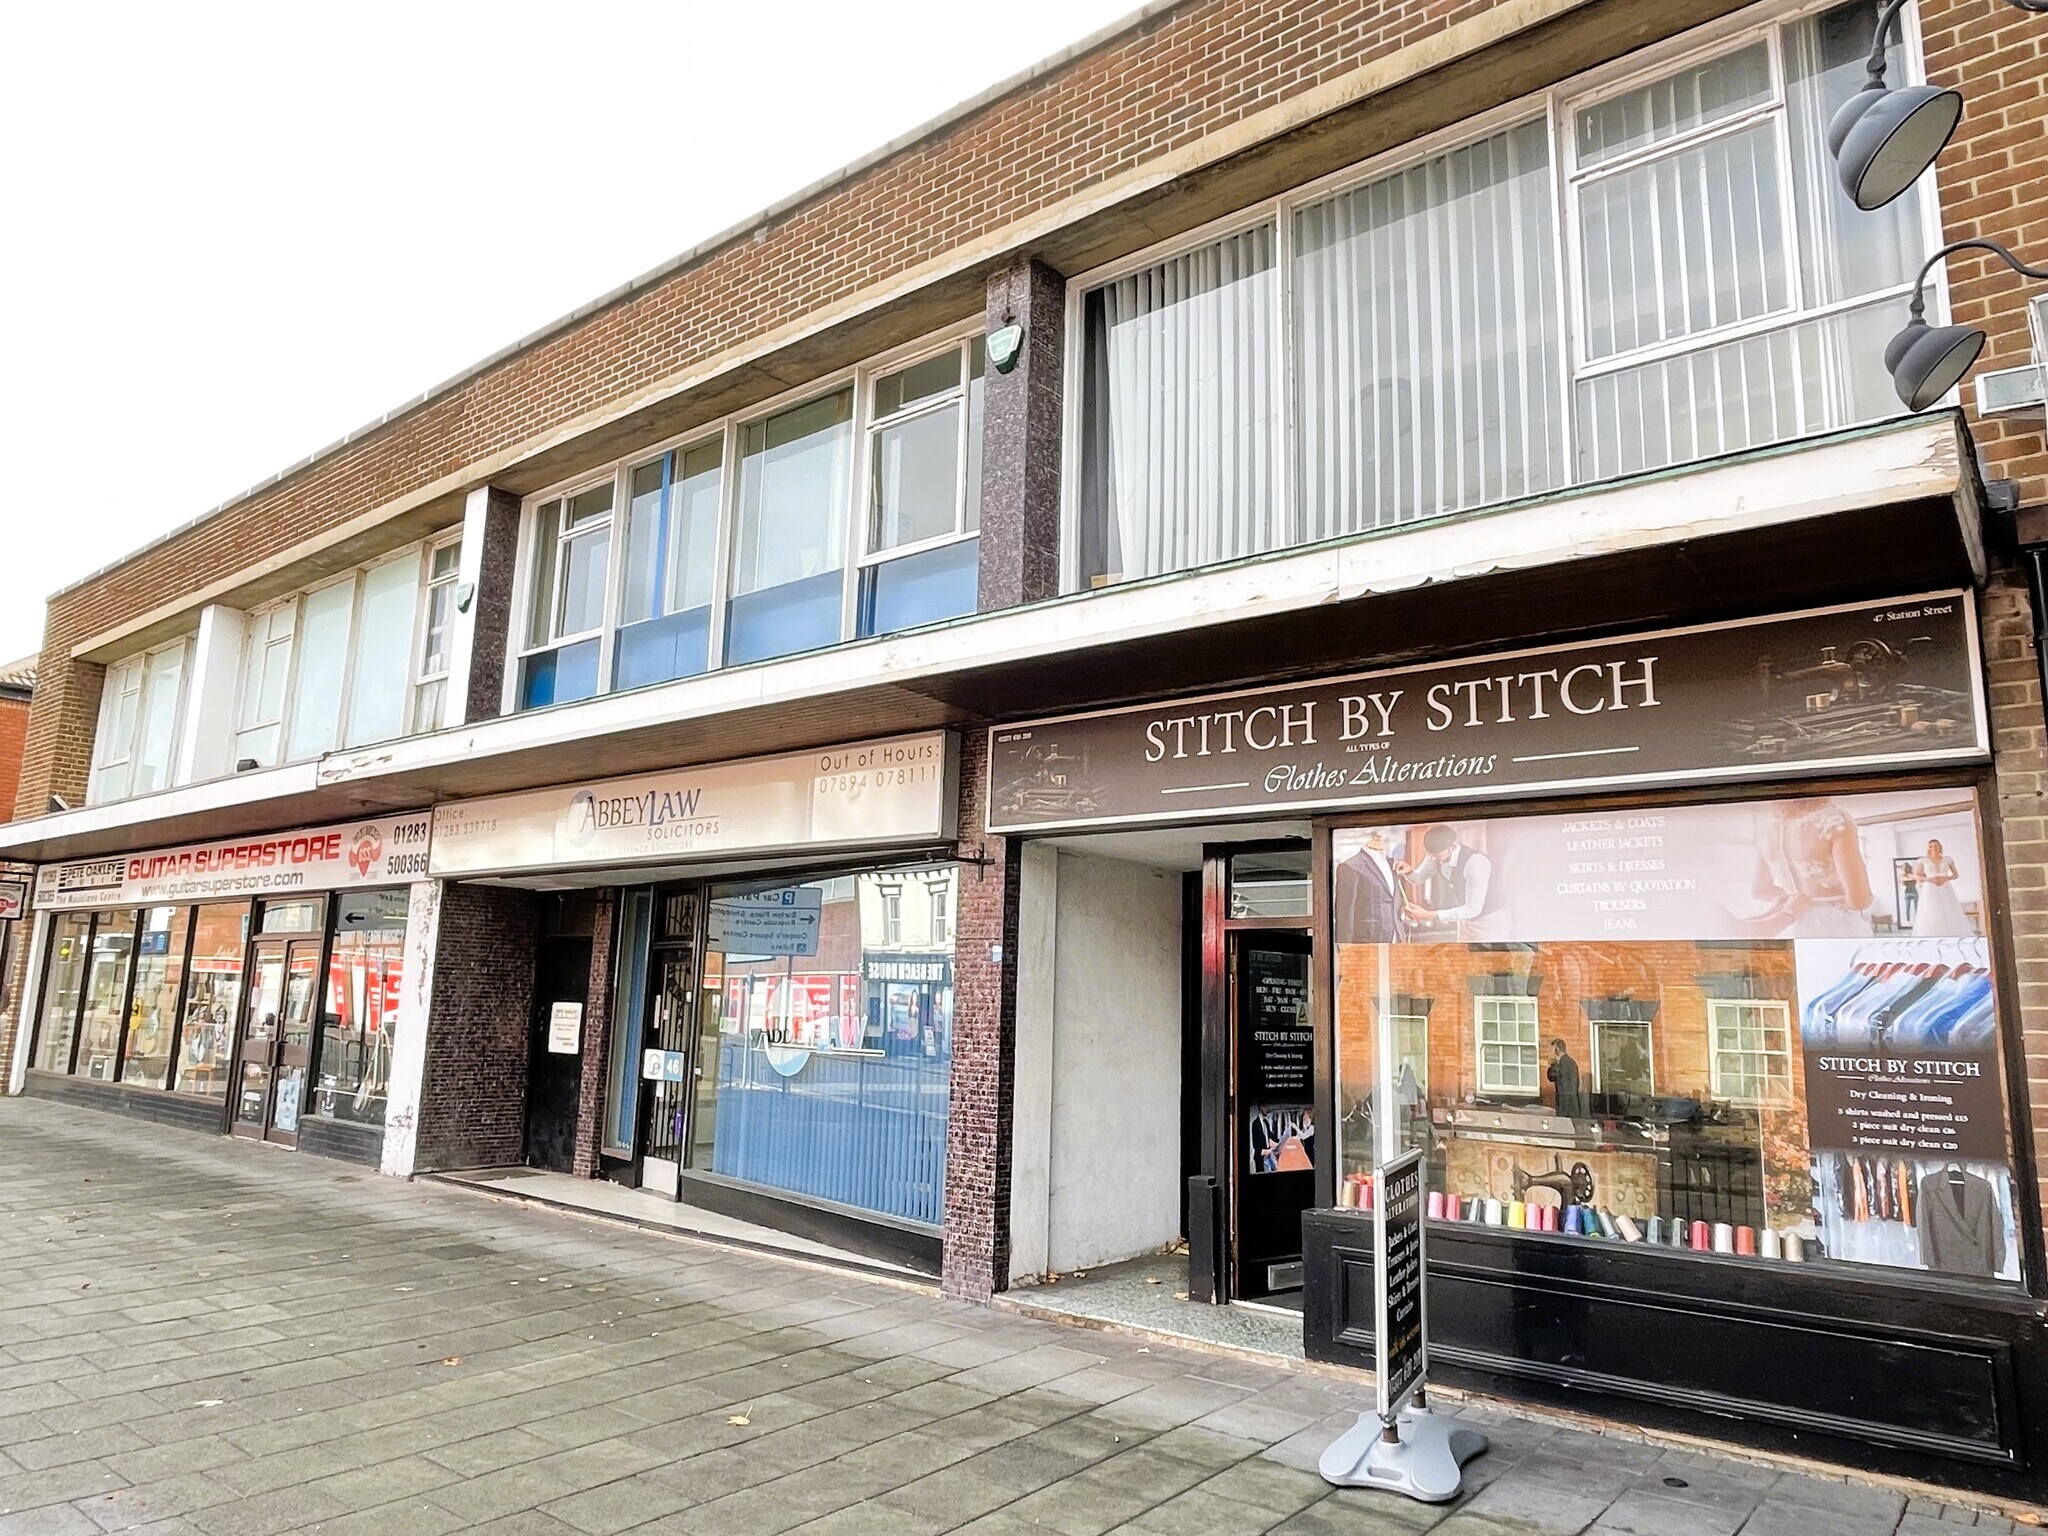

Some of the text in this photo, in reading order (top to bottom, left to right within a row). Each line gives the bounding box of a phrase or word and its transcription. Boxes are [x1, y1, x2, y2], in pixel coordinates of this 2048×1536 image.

[1886, 610, 1921, 621] Station
[1923, 605, 1953, 616] Street
[1145, 657, 1661, 762] STITCH BY STITCH
[820, 744, 940, 771] Out of Hours:
[820, 765, 936, 793] 07894 078111
[1264, 753, 1497, 793] Clothes Alterations
[646, 821, 720, 841] SOLICITORS
[1562, 816, 1666, 833] JACKETS & COATS
[394, 822, 427, 845] 01283
[1567, 836, 1664, 851] LEATHER JACKETS
[128, 853, 191, 880] GUITAR
[195, 833, 342, 873] SUPERSTORE
[387, 853, 428, 875] 500366
[67, 866, 84, 879] PETE
[86, 863, 117, 877] OAKLEY
[1568, 862, 1605, 874] SKIRTS
[1619, 859, 1665, 872] DRESSES
[141, 872, 303, 898] www.guitarsuperstore.com
[1557, 878, 1696, 895] CURTAINS BY QUOTATION
[1594, 899, 1647, 912] TROUSERS
[1604, 917, 1638, 931] JEANS
[1254, 1031, 1279, 1041] STITCH
[1290, 1032, 1313, 1042] STITCH
[666, 1059, 680, 1075] 46
[1819, 1056, 1981, 1077] STITCH BY STITCH
[1849, 1089, 1867, 1100] Dry
[1868, 1091, 1908, 1102] Cleaning
[1909, 1093, 1918, 1101] &
[1845, 1107, 1869, 1116] shirts
[1870, 1109, 1901, 1118] washed
[1902, 1111, 1919, 1119] and
[1859, 1122, 1880, 1131] piece
[1899, 1123, 1916, 1134] dry
[1917, 1124, 1941, 1134] clean
[1859, 1136, 1880, 1145] piece
[1899, 1137, 1916, 1149] dry
[1917, 1139, 1941, 1149] clean
[1385, 1170, 1418, 1203] CLOTHES
